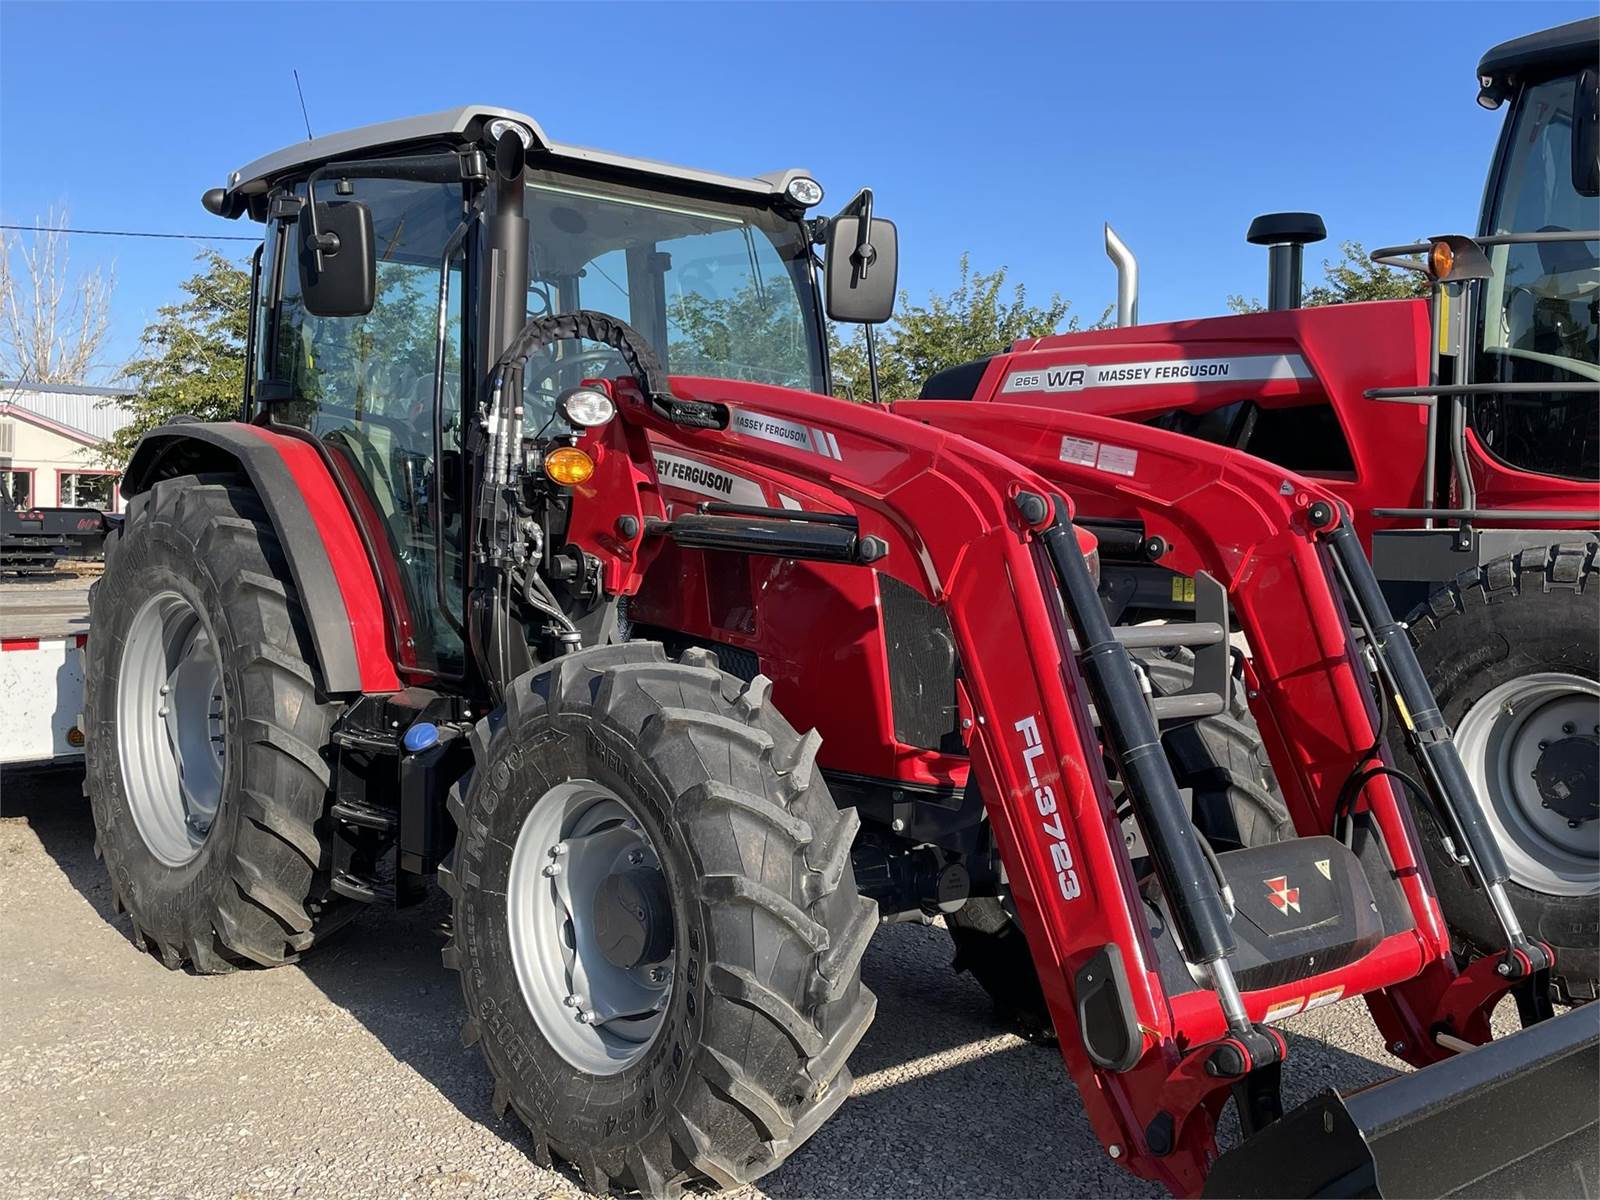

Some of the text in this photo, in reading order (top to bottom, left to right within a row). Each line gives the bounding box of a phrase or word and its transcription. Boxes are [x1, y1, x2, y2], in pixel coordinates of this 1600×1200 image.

[1015, 363, 1229, 387] 265 WR MASSEY FERGUSON
[765, 423, 807, 443] FERGUSON
[672, 462, 733, 494] FERGUSON
[1014, 715, 1081, 901] FL.3723
[462, 814, 489, 889] TM
